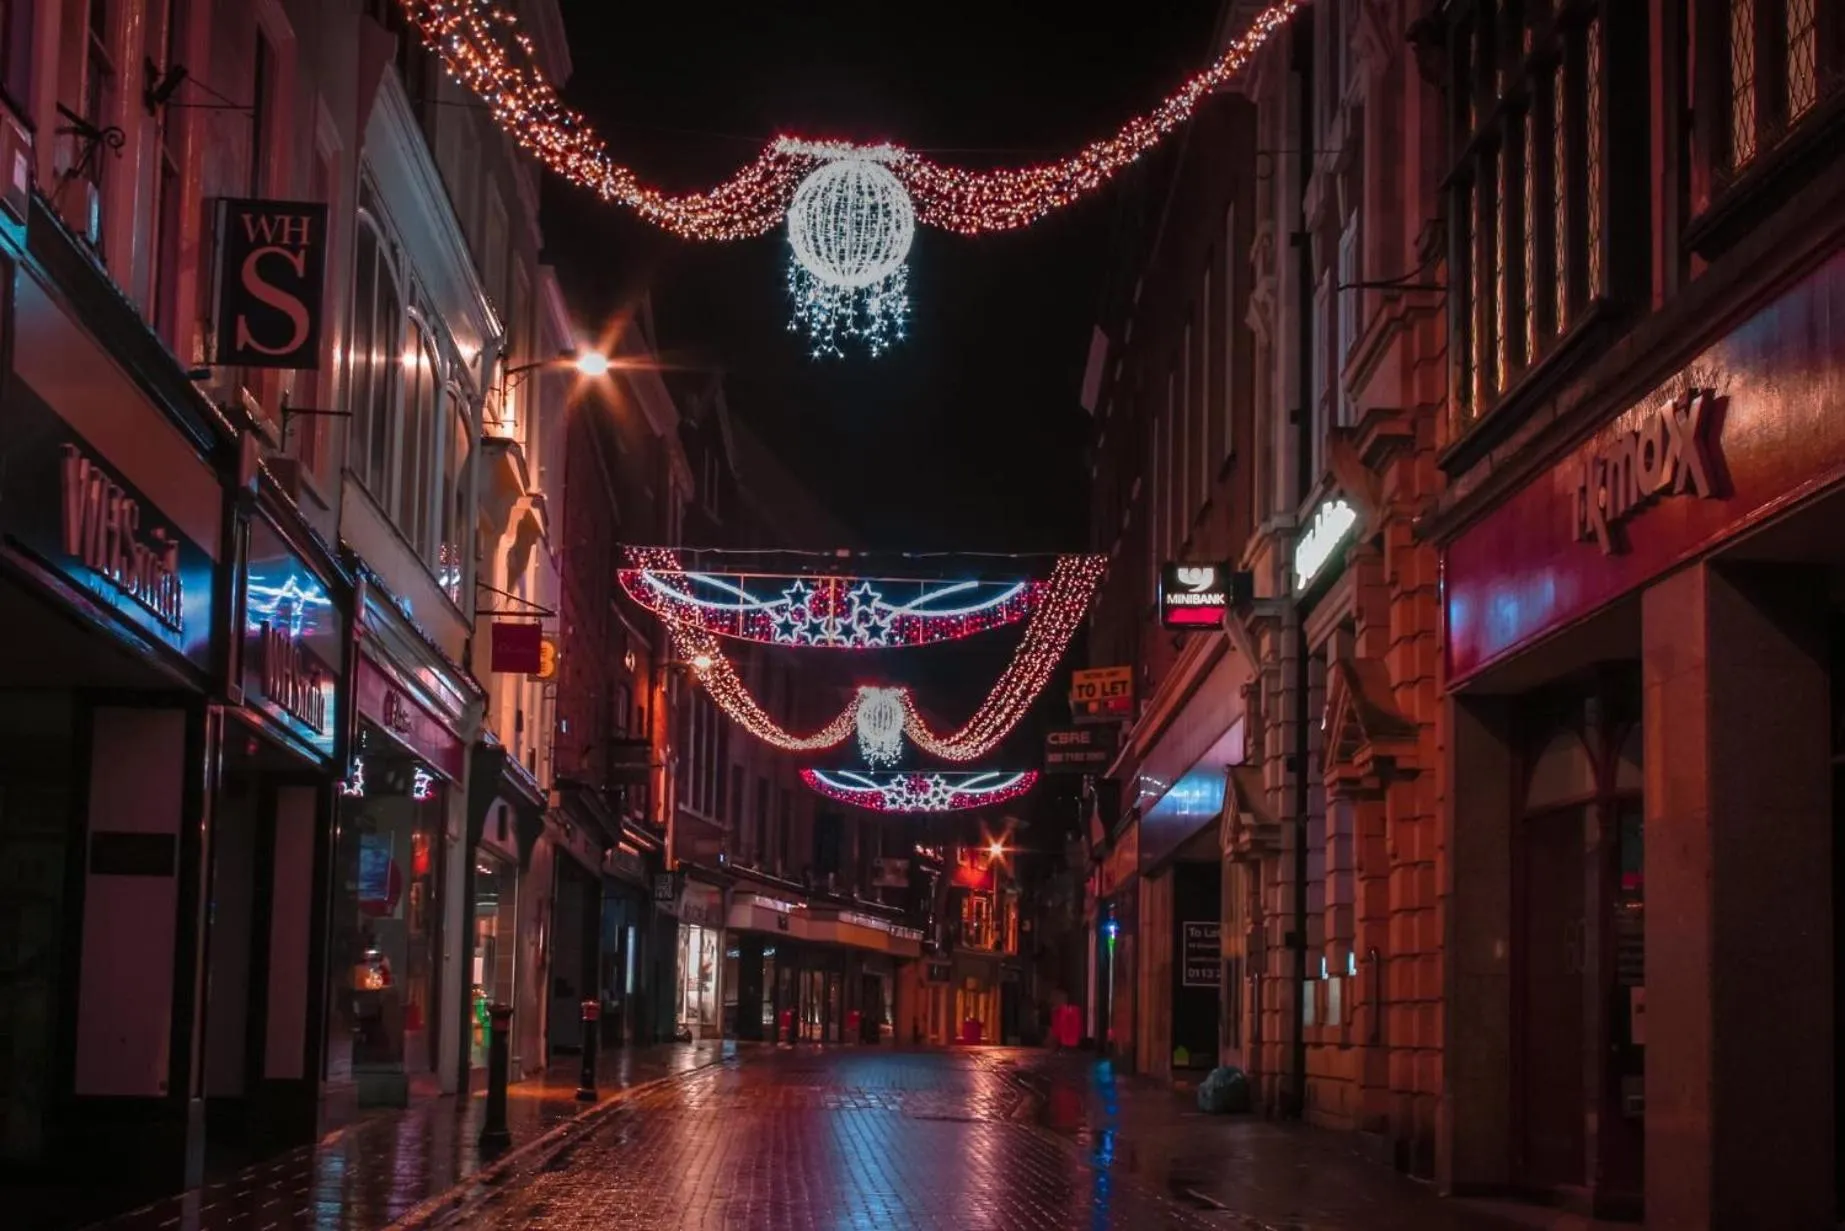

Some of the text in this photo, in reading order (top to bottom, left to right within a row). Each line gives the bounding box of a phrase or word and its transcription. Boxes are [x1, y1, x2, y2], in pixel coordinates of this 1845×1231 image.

[242, 213, 312, 244] WH
[236, 246, 310, 355] S
[1166, 593, 1225, 605] MINIBANK
[1077, 680, 1129, 699] TO LET
[1046, 730, 1091, 745] CBRE
[1187, 926, 1202, 938] To
